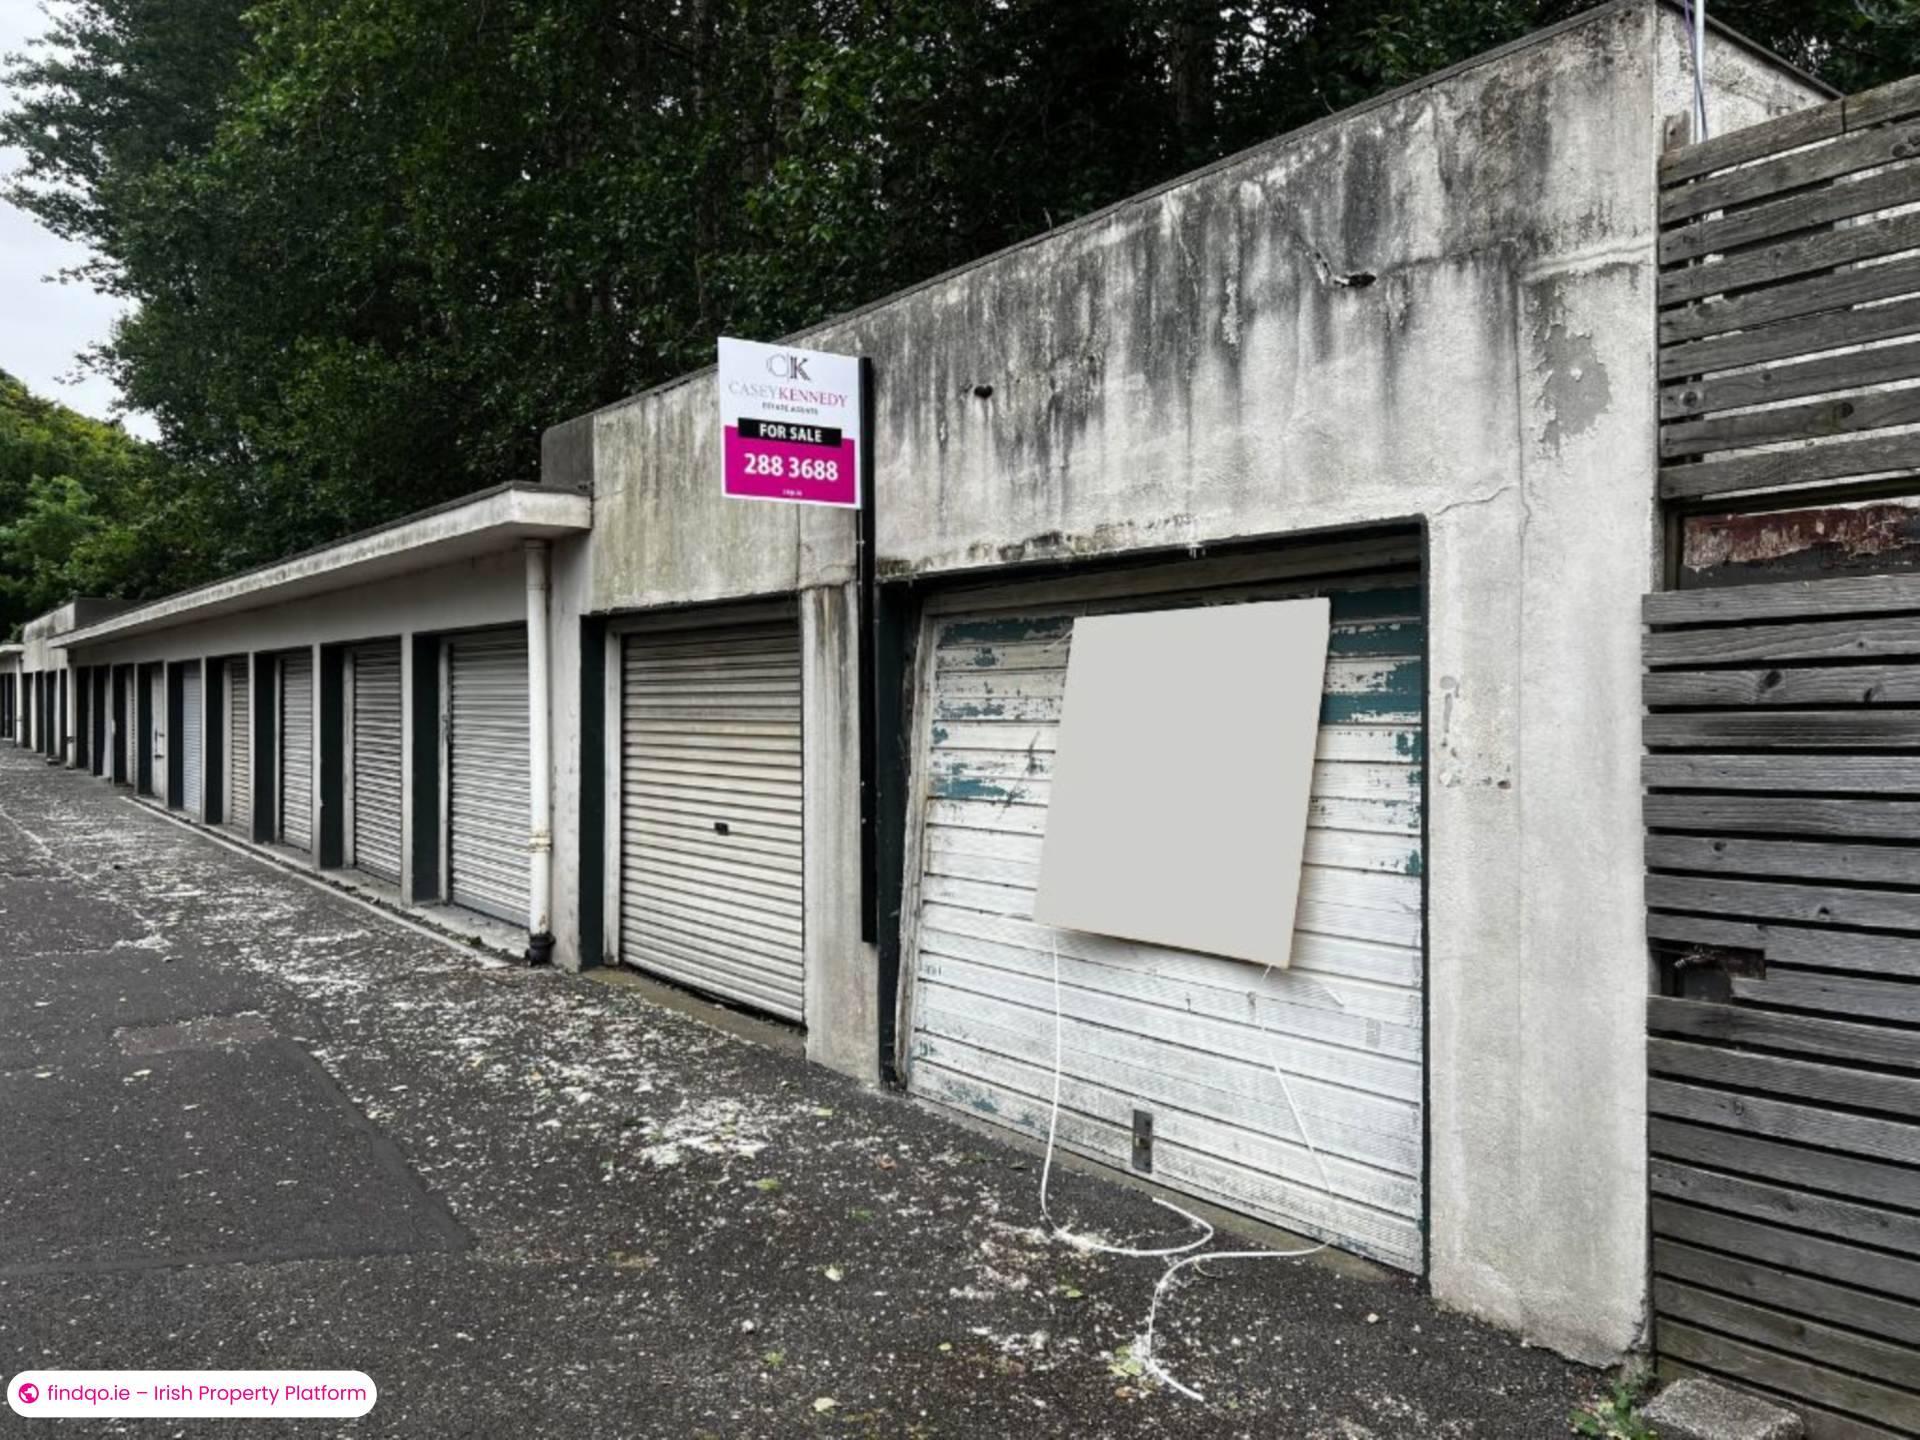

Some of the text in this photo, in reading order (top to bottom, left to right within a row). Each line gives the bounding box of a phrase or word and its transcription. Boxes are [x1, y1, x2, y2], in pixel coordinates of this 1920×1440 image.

[759, 423, 823, 443] FOR SALE
[744, 453, 839, 481] 288 3688
